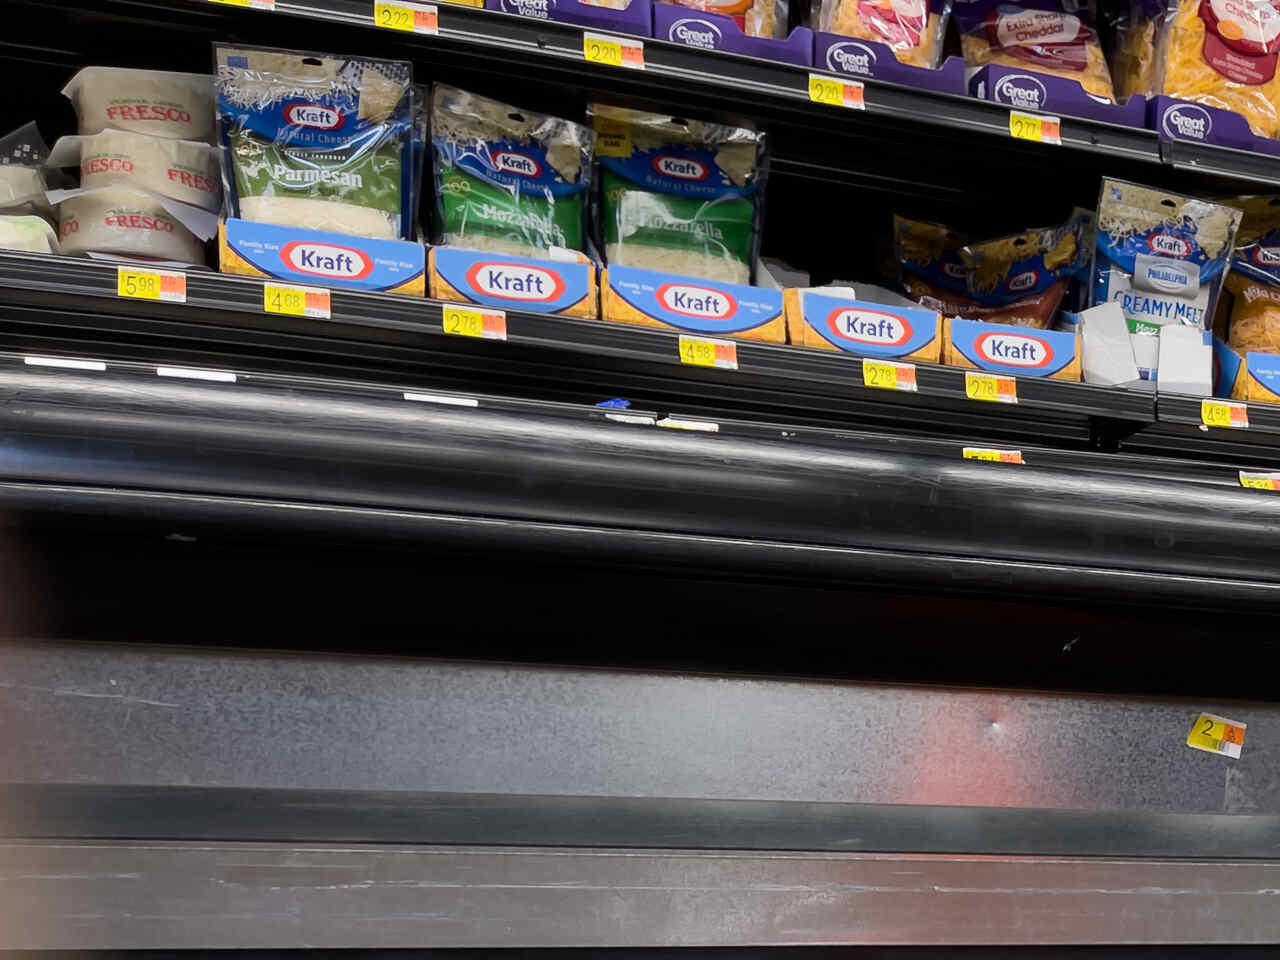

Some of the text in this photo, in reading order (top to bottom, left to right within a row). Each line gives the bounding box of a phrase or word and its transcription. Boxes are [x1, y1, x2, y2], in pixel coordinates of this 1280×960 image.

[676, 26, 714, 44] Great
[833, 49, 870, 66] Great
[1002, 83, 1041, 102] Great
[106, 106, 192, 124] FRESCO
[295, 109, 332, 125] Kraft
[1170, 110, 1206, 132] Great
[502, 155, 534, 175] Kraft
[663, 160, 697, 177] Kraft
[274, 164, 363, 188] Parmesan
[1156, 237, 1183, 254] Kraft
[300, 249, 353, 273] Kraft
[489, 269, 544, 294] Kraft
[674, 291, 720, 314] Kraft
[1114, 290, 1172, 319] CREAMY
[845, 314, 896, 340] Kraft
[992, 339, 1037, 361] Kraft
